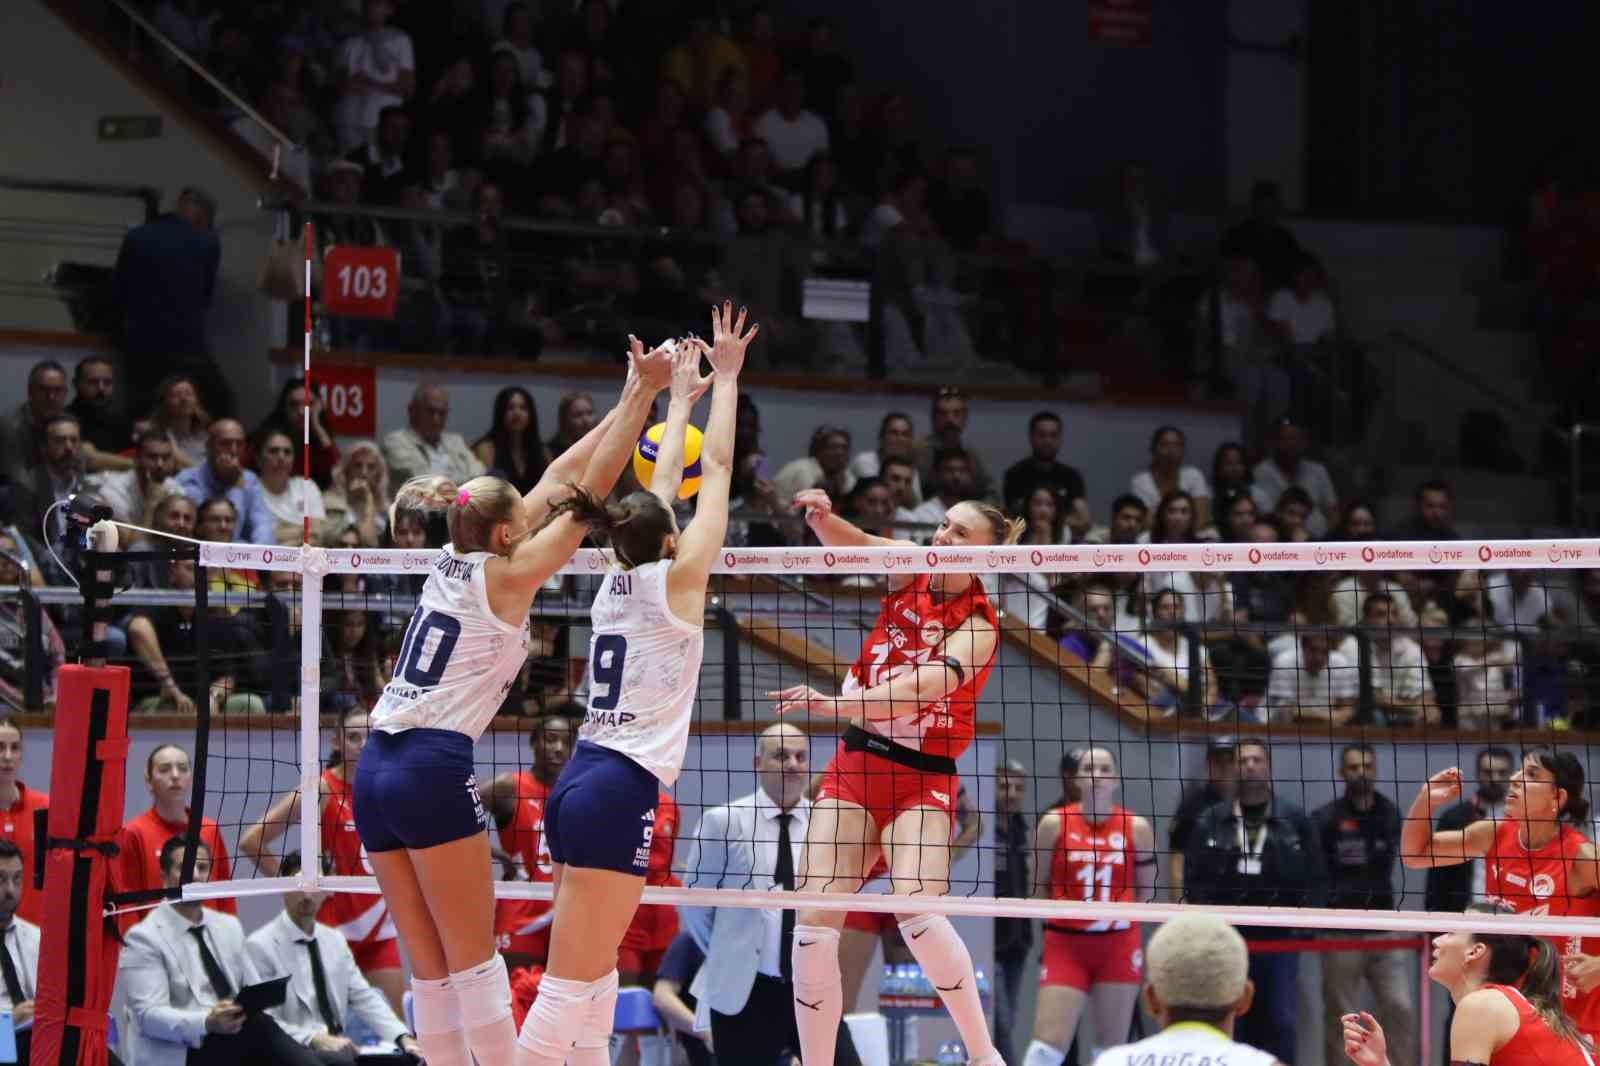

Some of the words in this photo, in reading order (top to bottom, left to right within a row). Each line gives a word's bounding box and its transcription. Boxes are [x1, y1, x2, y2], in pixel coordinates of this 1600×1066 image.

[338, 266, 387, 298] 103
[319, 384, 364, 417] 103
[1044, 553, 1079, 562] vodafone
[1153, 552, 1187, 561] vodafone
[1216, 553, 1233, 562] TVF
[1263, 551, 1298, 561] vodafone
[1328, 552, 1348, 561] TVF
[1377, 550, 1414, 559] vodafone
[1443, 551, 1463, 560] TVF
[1494, 548, 1531, 558] vodafone
[1563, 550, 1583, 559] TVF
[362, 555, 391, 565] vodafone
[414, 557, 429, 566] TVF
[737, 554, 769, 564] vodafone
[795, 557, 811, 566] TVF
[837, 554, 870, 564] vodafone
[896, 556, 913, 565] TVF
[940, 554, 973, 564] vodafone
[1000, 556, 1017, 565] TVF
[1107, 554, 1124, 563] TVF
[394, 605, 462, 687] 10
[592, 634, 627, 710] 9
[643, 826, 654, 847] 9
[1076, 863, 1113, 904] 11
